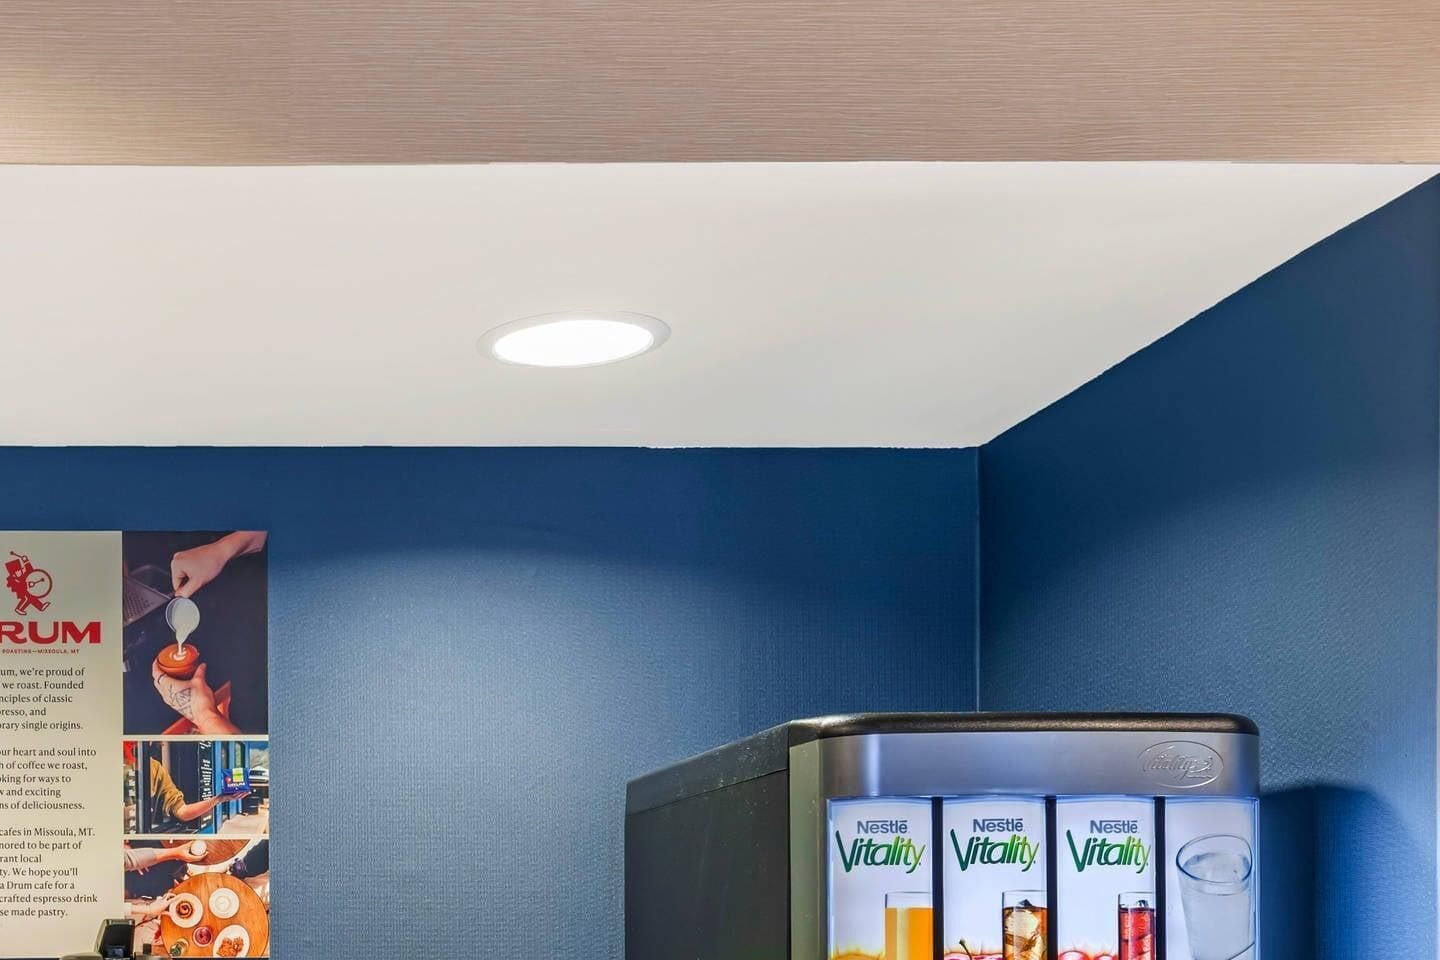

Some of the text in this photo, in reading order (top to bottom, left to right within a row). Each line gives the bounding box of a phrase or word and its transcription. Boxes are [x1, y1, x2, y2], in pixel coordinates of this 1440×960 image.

[45, 666, 73, 679] proud
[74, 666, 86, 676] of
[16, 681, 43, 689] roast.
[44, 679, 84, 689] Founded
[32, 693, 43, 703] of
[43, 693, 73, 703] classic
[30, 706, 46, 716] and
[21, 720, 48, 733] single
[50, 720, 84, 733] origins.
[13, 746, 36, 756] heart
[39, 746, 55, 756] and
[57, 746, 76, 756] soul
[78, 746, 97, 756] into
[5, 760, 17, 770] of
[17, 760, 46, 770] coffee
[47, 762, 61, 770] we
[62, 761, 88, 771] roast,
[23, 773, 36, 783] for
[38, 775, 60, 786] ways
[61, 774, 72, 783] to
[6, 786, 23, 796] and
[24, 786, 62, 800] exciting
[10, 800, 21, 810] of
[22, 800, 85, 810] deliciousness.
[23, 826, 32, 836] in
[34, 826, 77, 838] Missoula,
[27, 841, 37, 850] to
[39, 840, 50, 850] be
[52, 841, 71, 853] part
[72, 840, 83, 850] of
[835, 829, 926, 874] Vitality
[949, 828, 1040, 873] Vitality
[1066, 829, 1152, 874] Vitality
[19, 853, 42, 863] local
[12, 867, 27, 876] We
[28, 867, 52, 880] hope
[0, 882, 5, 890] a
[7, 880, 33, 890] Drum
[34, 880, 53, 890] cafe
[55, 880, 68, 890] for
[69, 882, 75, 890] a
[32, 895, 73, 906] espresso
[73, 893, 98, 903] drink
[11, 907, 36, 916] made
[38, 908, 68, 920] pastry.
